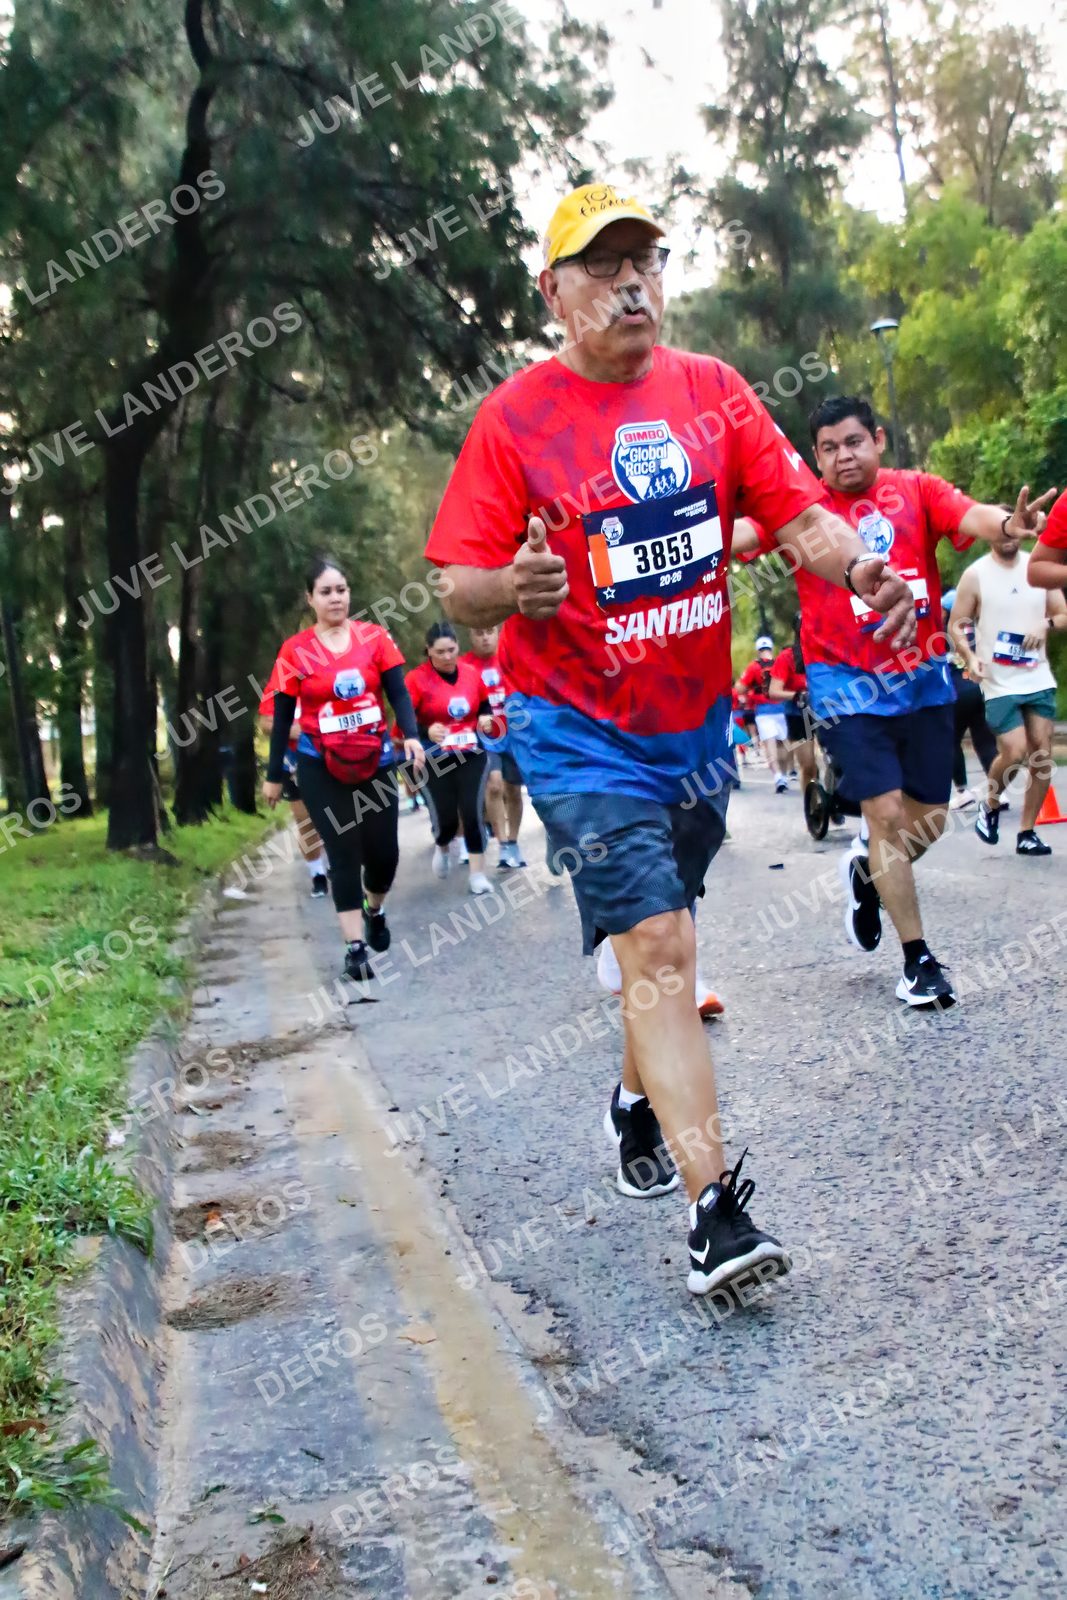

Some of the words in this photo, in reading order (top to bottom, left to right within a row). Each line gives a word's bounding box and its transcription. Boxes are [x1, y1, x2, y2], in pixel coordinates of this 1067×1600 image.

[623, 429, 665, 443] BIMBO
[629, 444, 667, 462] Global
[625, 461, 656, 477] Race
[633, 532, 694, 574] 3853
[605, 590, 723, 644] SANTIAGO
[338, 713, 363, 729] 1986
